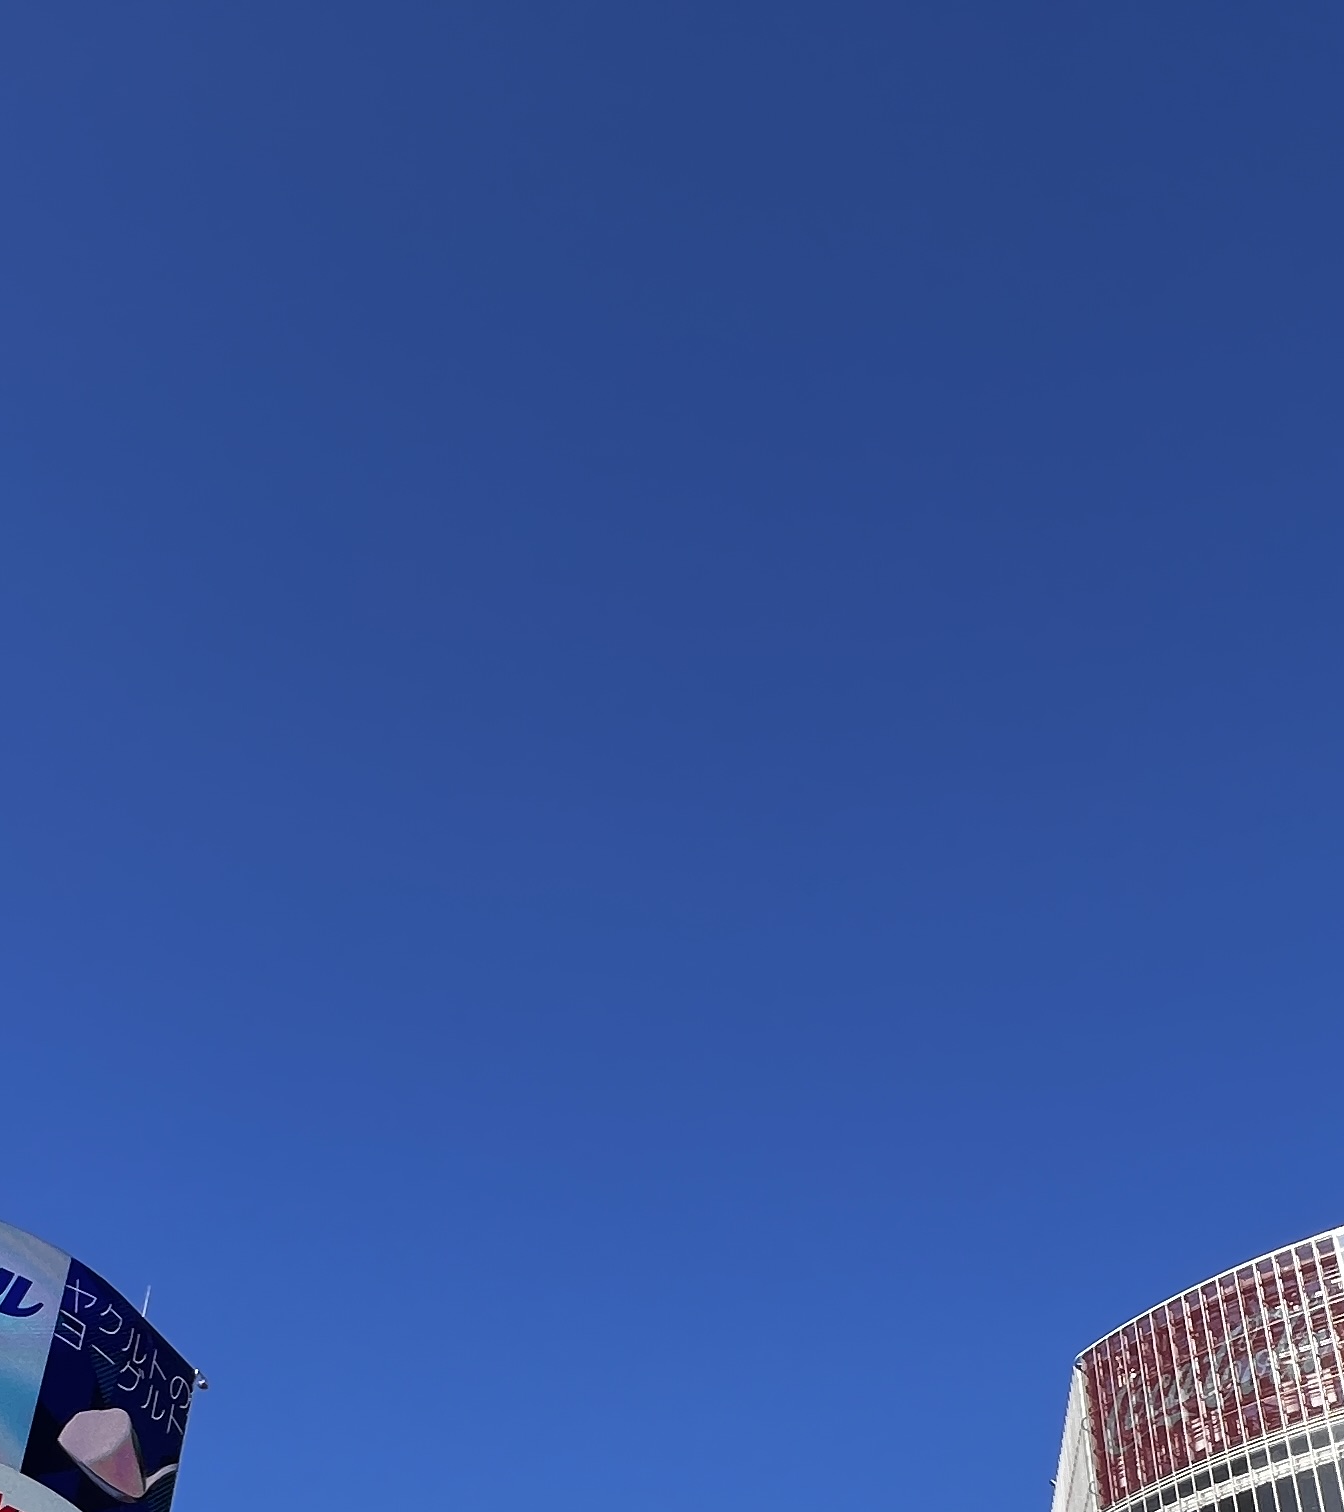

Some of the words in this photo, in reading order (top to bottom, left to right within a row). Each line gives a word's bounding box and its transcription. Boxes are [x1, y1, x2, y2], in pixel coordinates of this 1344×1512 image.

[54, 1309, 184, 1436] ヨーグルト
[65, 1278, 191, 1409] ヤクルトの
